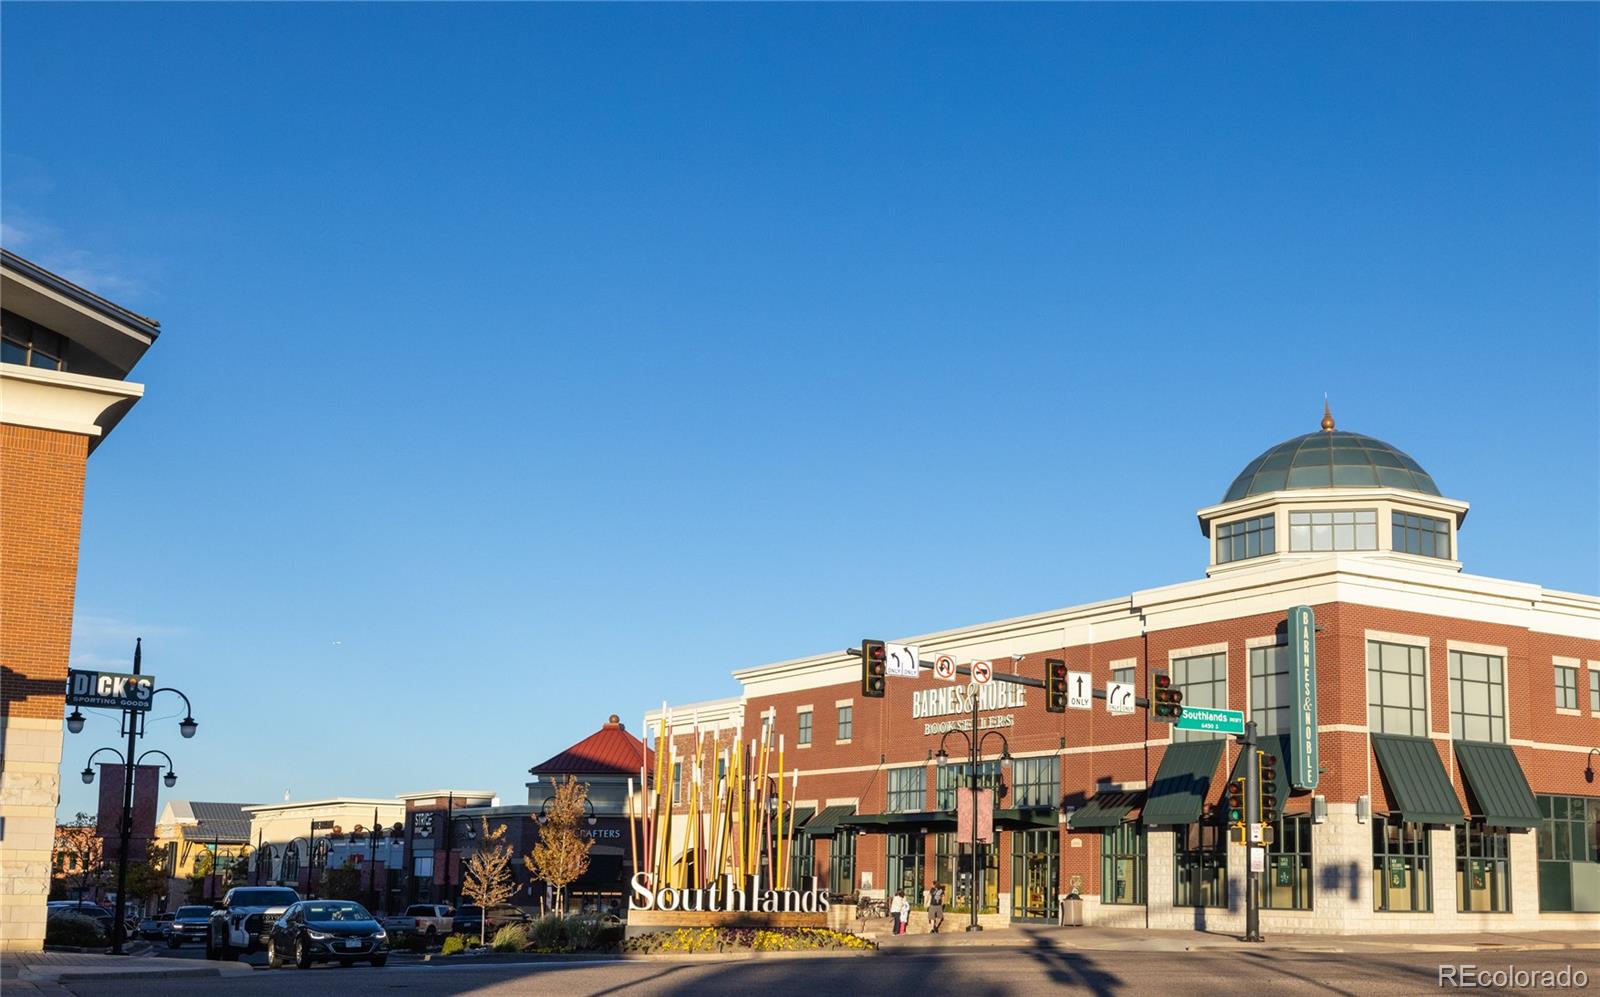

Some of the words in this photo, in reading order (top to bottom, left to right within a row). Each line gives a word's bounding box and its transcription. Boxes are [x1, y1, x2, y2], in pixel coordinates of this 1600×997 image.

[73, 673, 151, 700] DICK'S
[73, 696, 116, 705] SPORTING
[121, 699, 149, 707] GOODS
[1071, 697, 1089, 706] ONLY
[924, 713, 1014, 736] BOOKSELERS
[1182, 709, 1228, 722] Southlands
[628, 871, 830, 913] Southlands
